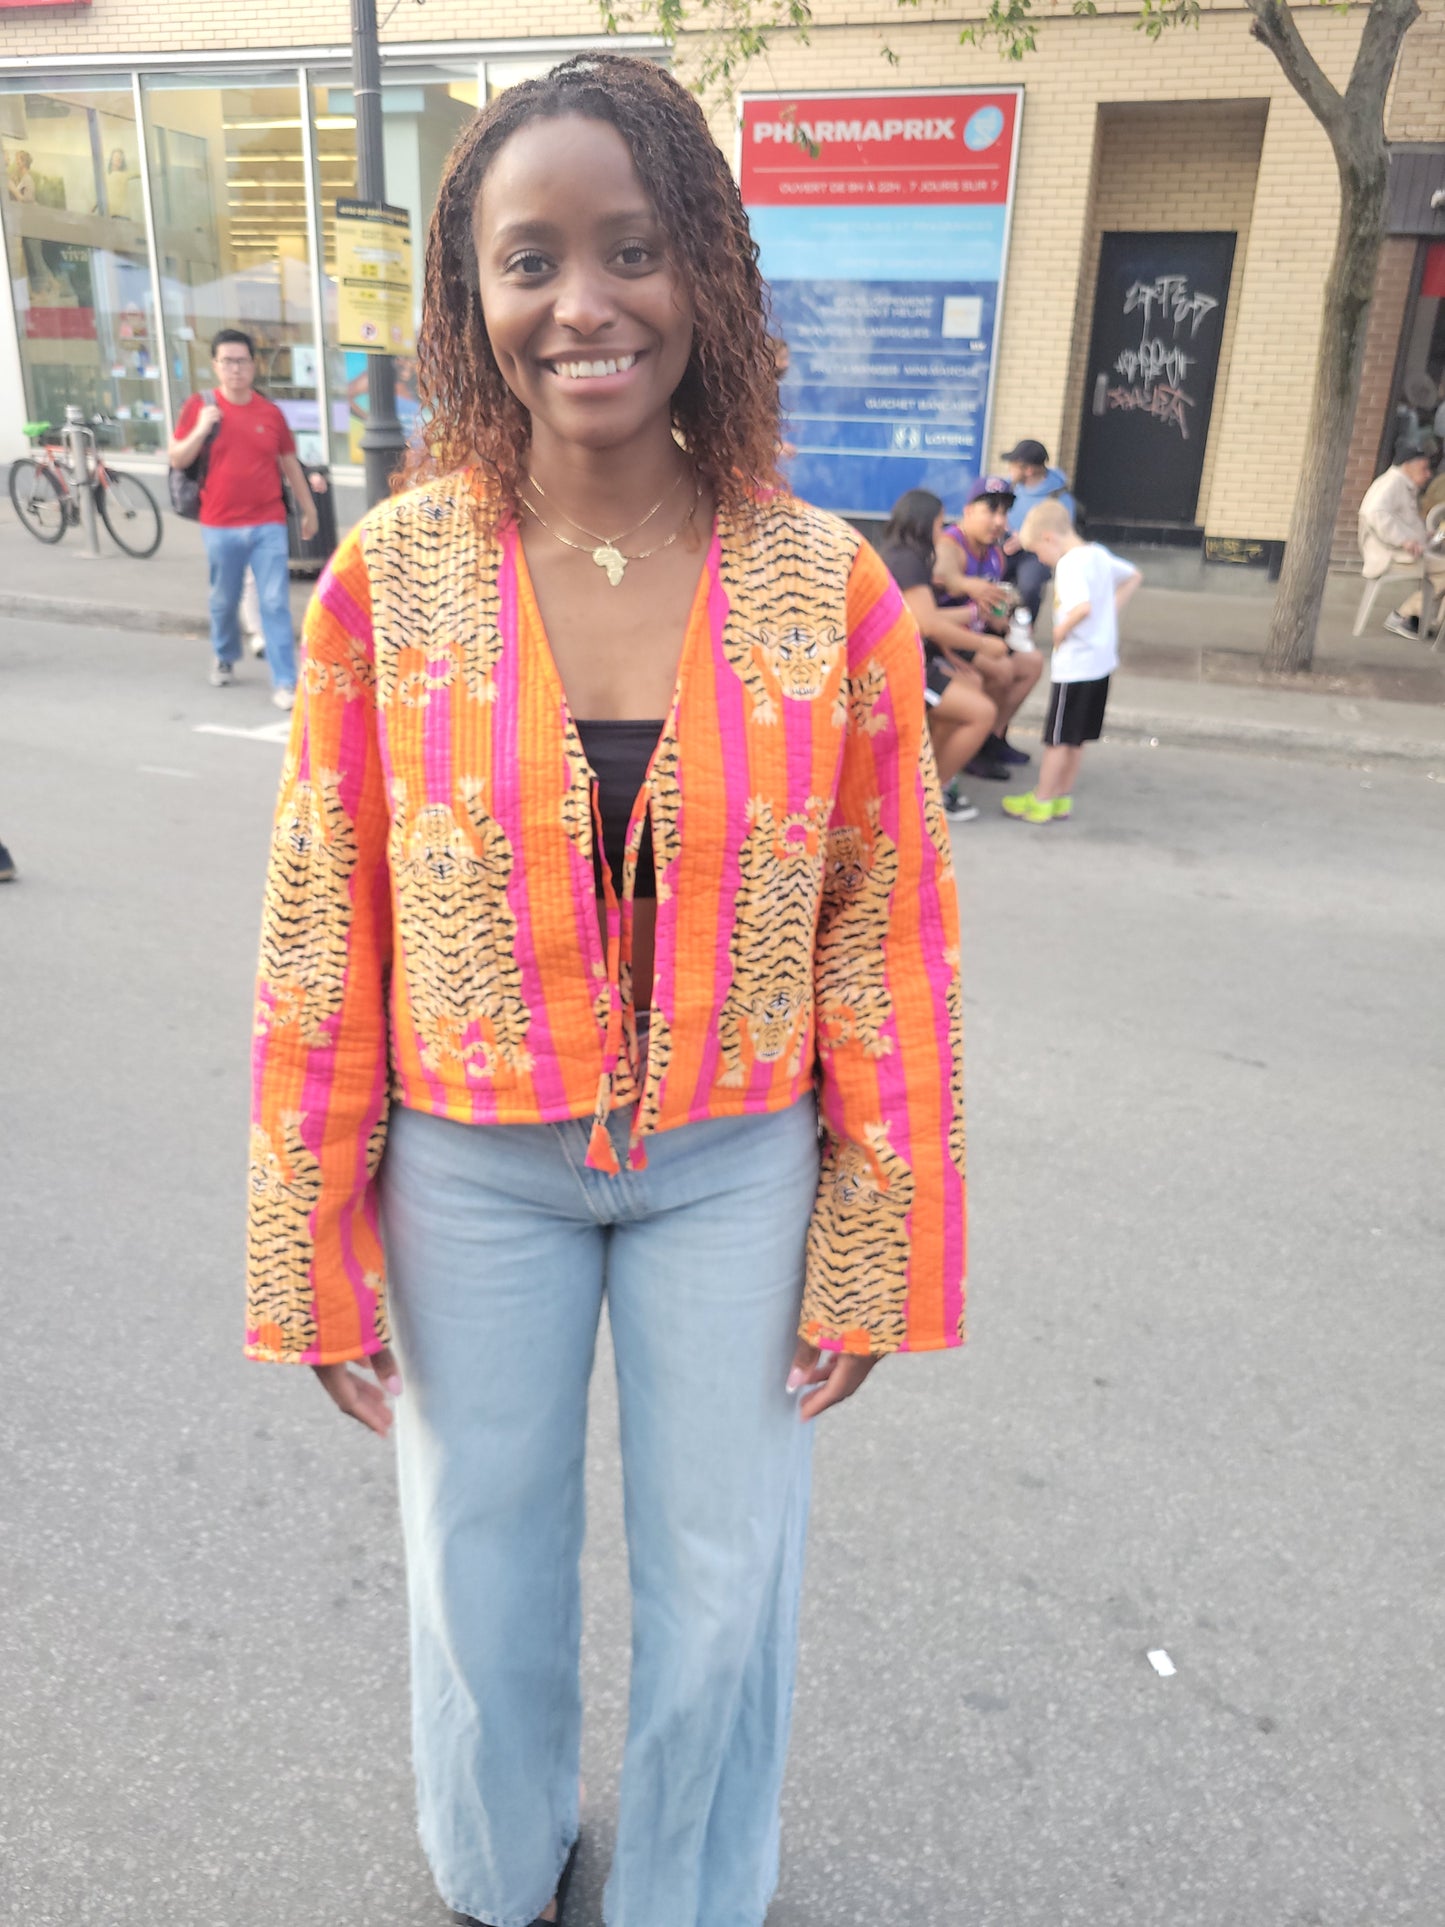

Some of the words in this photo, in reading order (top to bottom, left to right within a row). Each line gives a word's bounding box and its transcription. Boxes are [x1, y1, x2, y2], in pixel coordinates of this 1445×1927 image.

[753, 118, 955, 143] PHARMAPRIX
[779, 181, 827, 194] OUVERT
[829, 181, 845, 193] DE
[920, 180, 959, 192] JOURS
[961, 179, 988, 192] SUR
